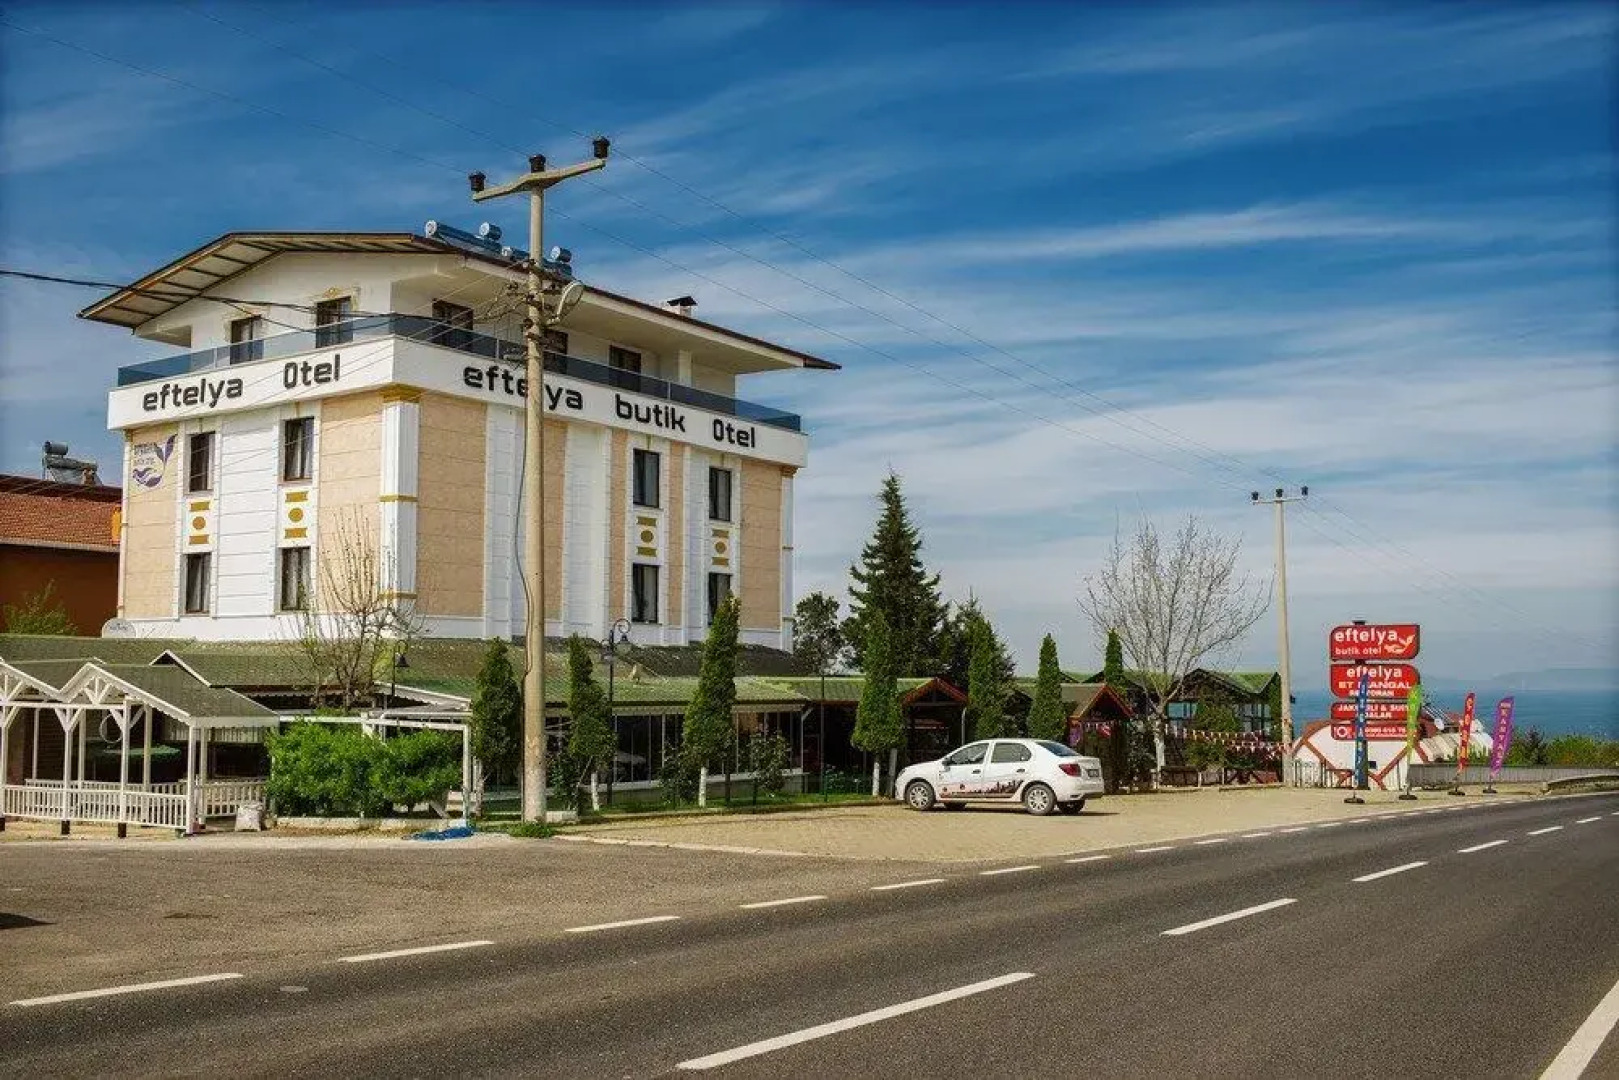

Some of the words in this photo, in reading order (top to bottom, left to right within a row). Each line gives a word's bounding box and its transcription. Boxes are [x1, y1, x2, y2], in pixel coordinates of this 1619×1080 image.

[143, 377, 243, 411] eftelya
[284, 354, 341, 389] Otel
[463, 365, 583, 411] efteya
[615, 394, 685, 432] butik
[713, 418, 756, 448] Otel
[1334, 627, 1398, 645] eftelya
[1335, 647, 1360, 655] butik
[1362, 647, 1381, 655] otel
[1346, 665, 1402, 680] eftelya
